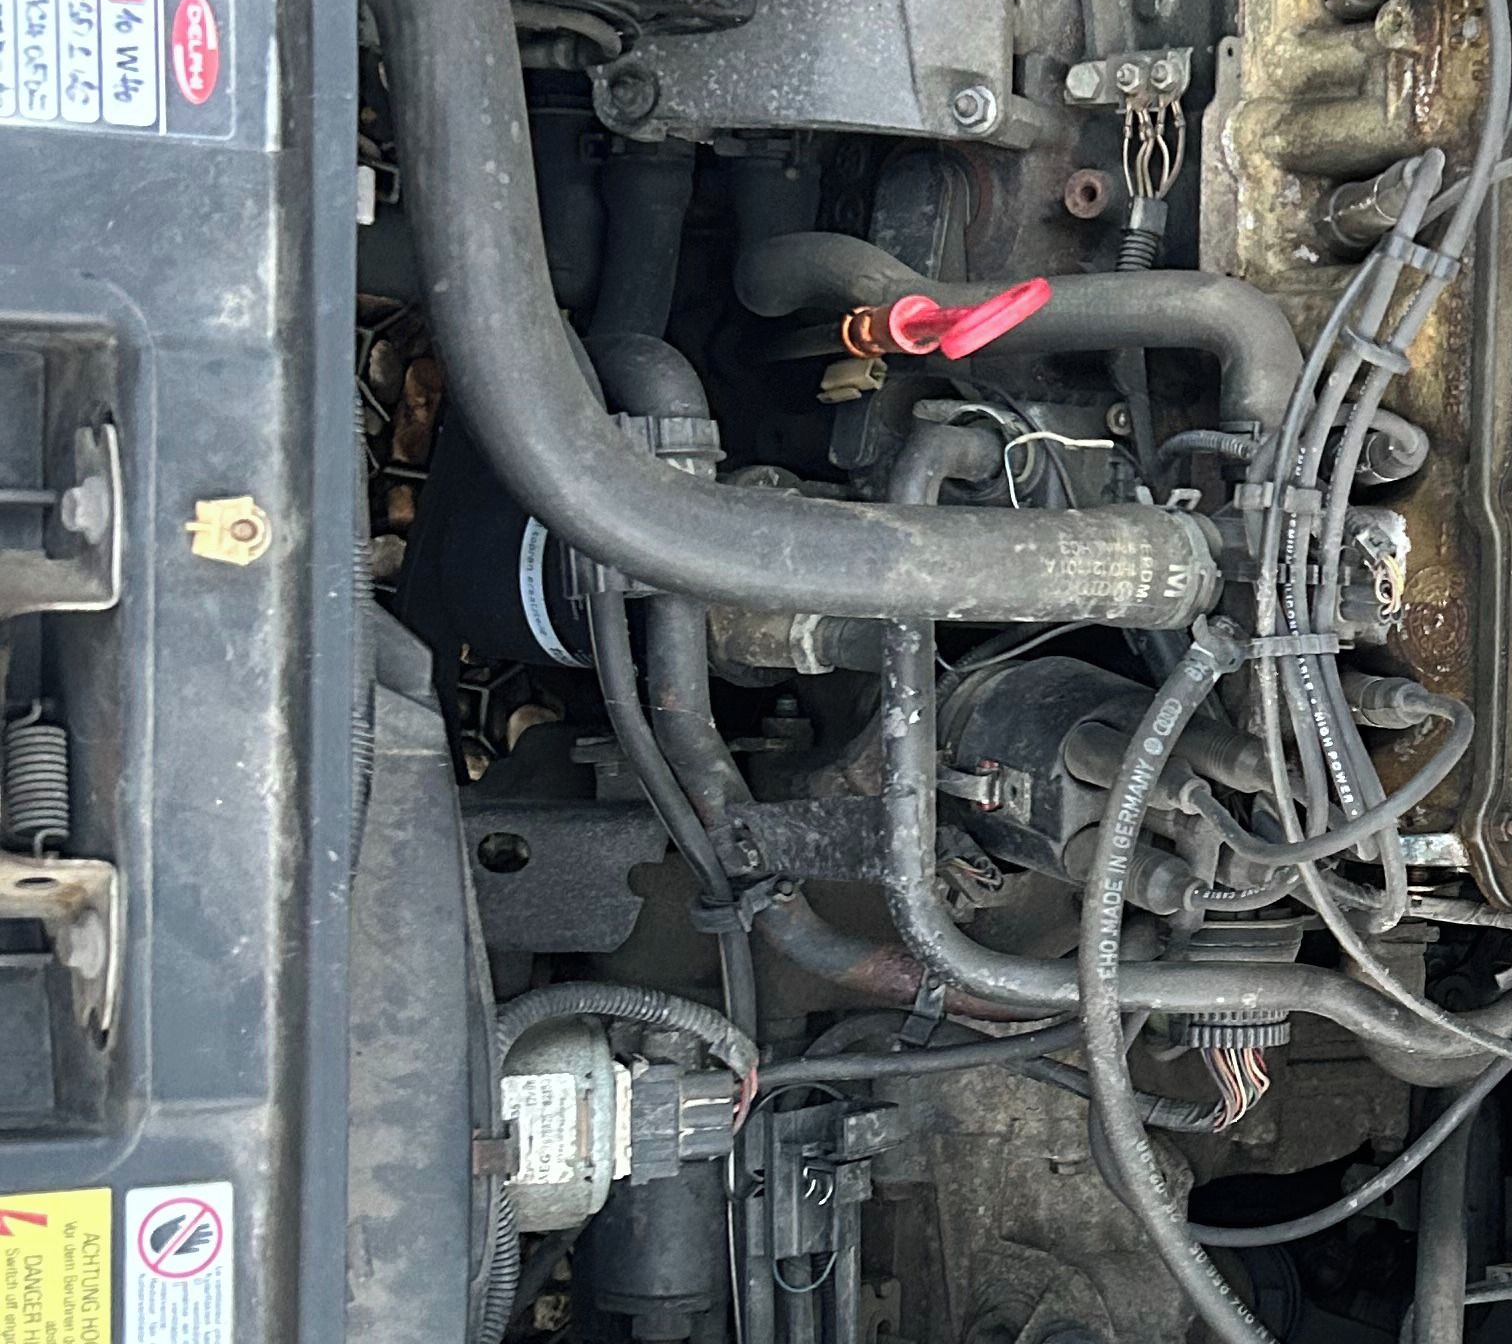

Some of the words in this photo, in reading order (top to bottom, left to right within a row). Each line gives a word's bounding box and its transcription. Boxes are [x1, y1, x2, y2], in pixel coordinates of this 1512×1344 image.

[186, 4, 204, 90] DELPHI
[1314, 712, 1332, 747] HIGH
[1328, 751, 1354, 803] POWER
[1112, 756, 1154, 849] GERMANY
[1108, 855, 1127, 874] IN
[1103, 879, 1124, 930] MADE
[5, 1248, 19, 1290] Switch
[5, 1294, 17, 1309] off
[23, 1255, 42, 1324] DANGER
[82, 1233, 100, 1312] ACHTUNG
